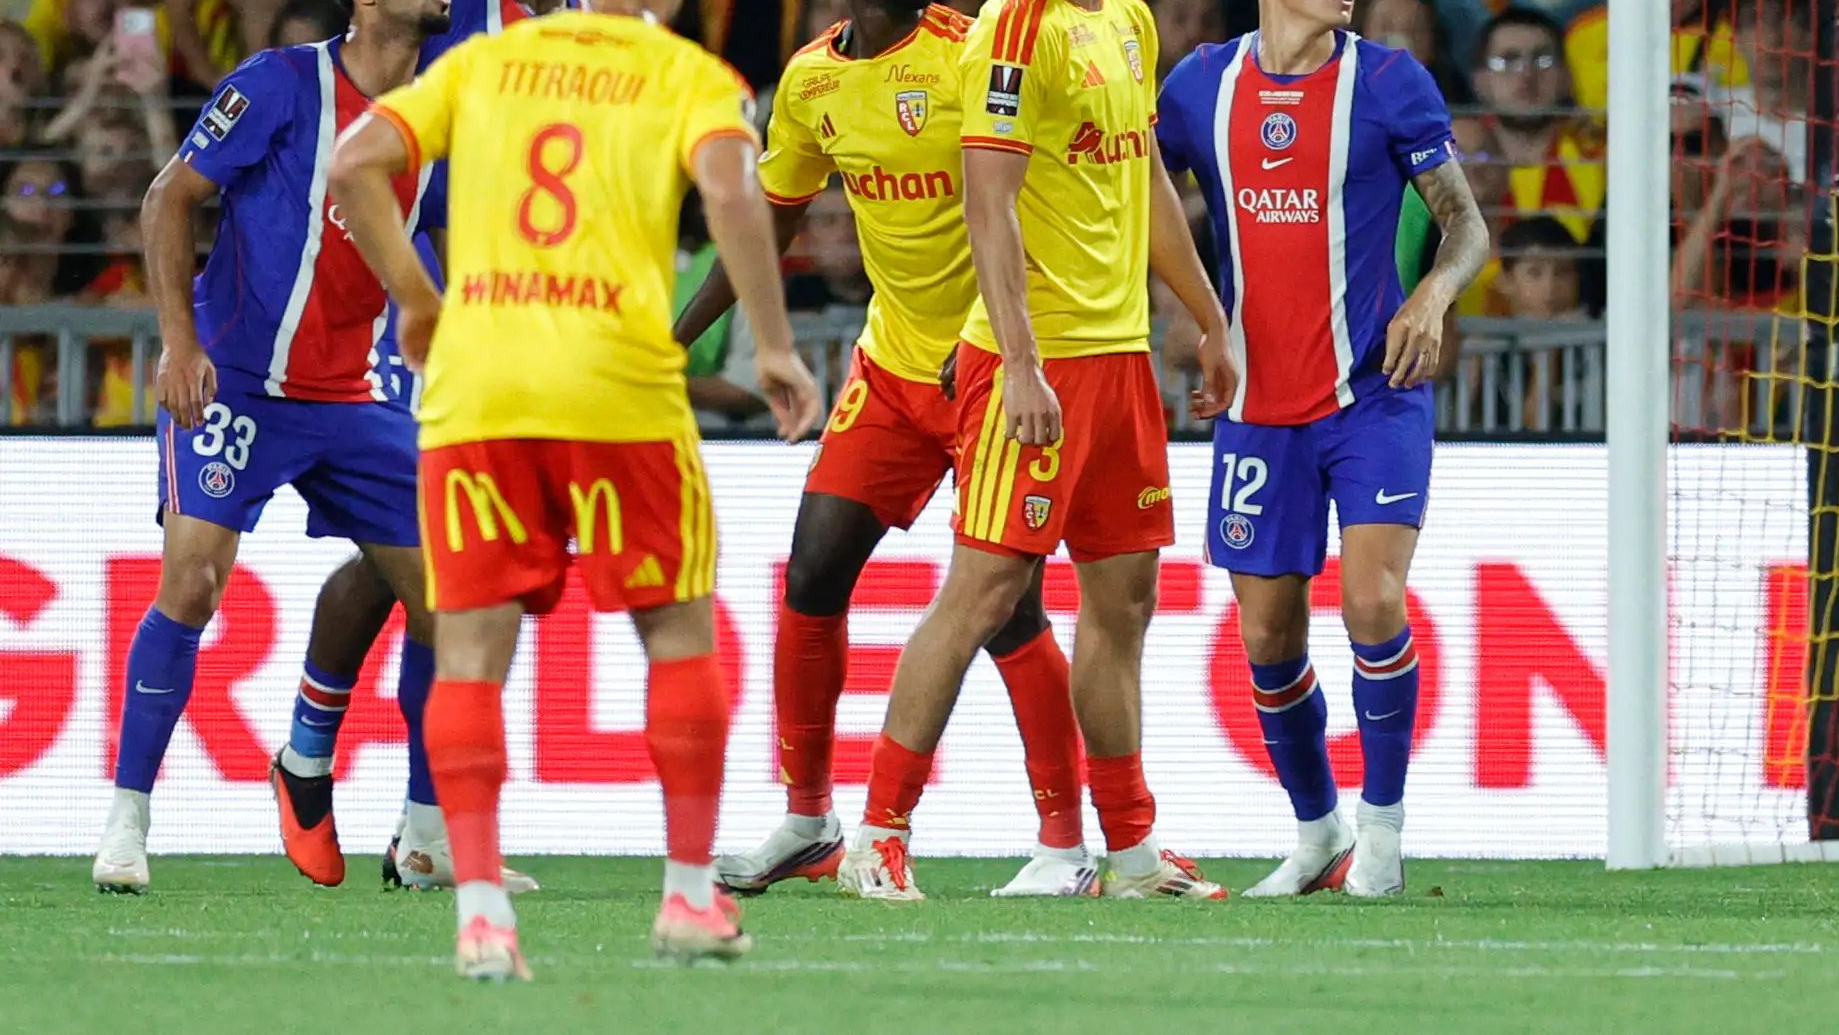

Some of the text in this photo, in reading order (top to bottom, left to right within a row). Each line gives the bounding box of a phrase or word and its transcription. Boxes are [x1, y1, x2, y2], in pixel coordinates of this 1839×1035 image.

[499, 62, 646, 105] TITRAOUI
[884, 64, 940, 83] Nexans
[515, 122, 584, 249] 8
[841, 165, 955, 201] uchan
[1238, 187, 1319, 212] QATAR
[1256, 210, 1320, 224] AIRWAYS
[461, 270, 624, 316] WINAMAX
[192, 402, 257, 471] 33
[1221, 453, 1268, 516] 12
